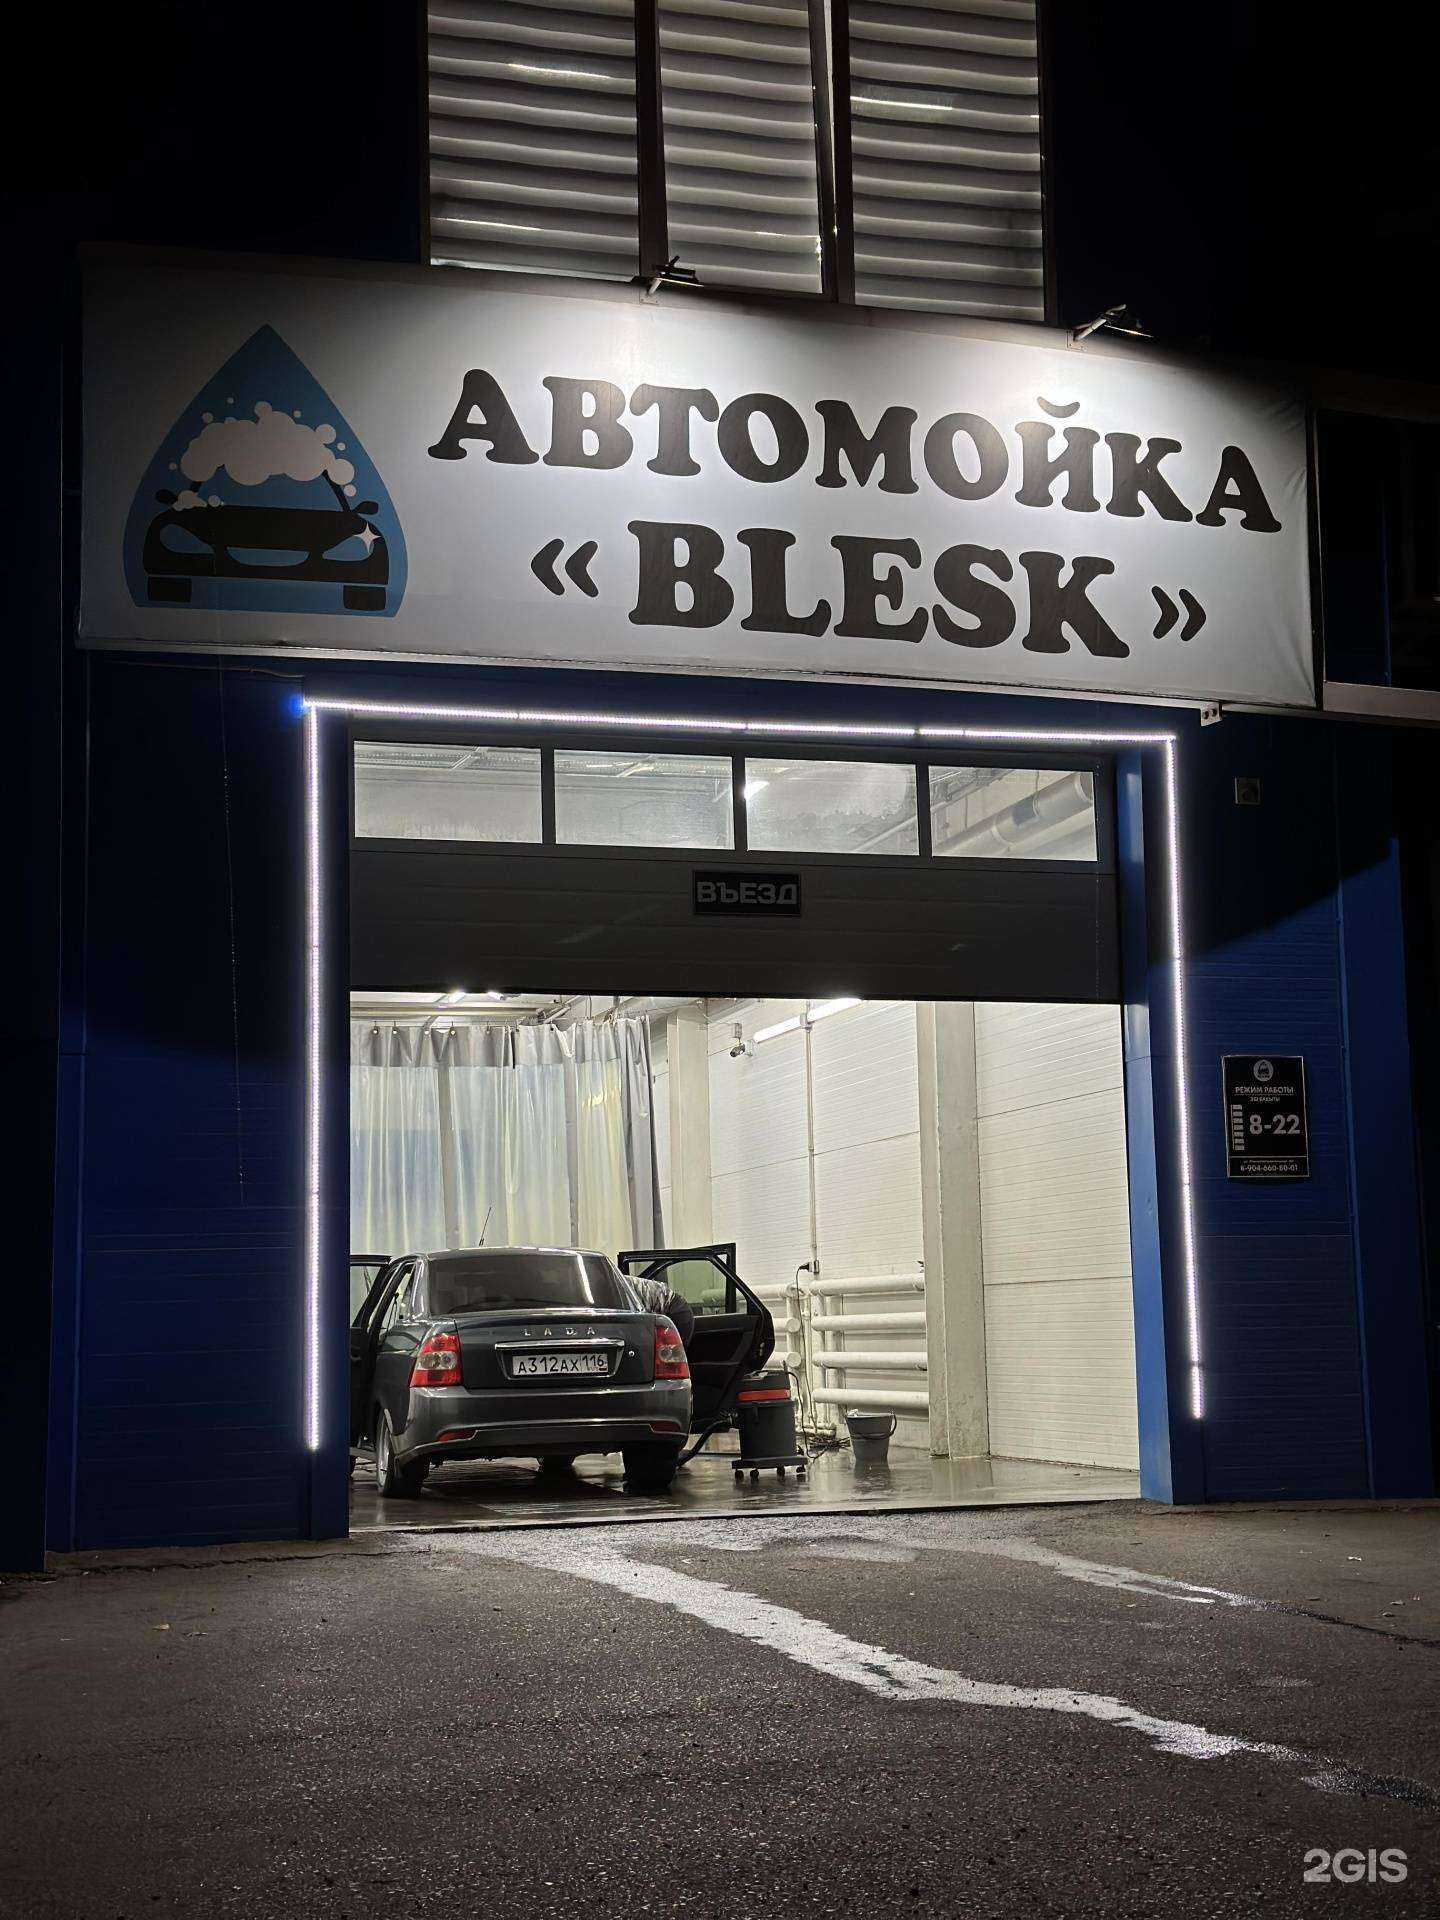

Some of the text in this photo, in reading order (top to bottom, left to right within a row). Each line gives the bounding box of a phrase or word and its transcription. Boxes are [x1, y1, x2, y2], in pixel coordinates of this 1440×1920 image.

[427, 368, 1281, 533] АВТОМОЙКА
[696, 881, 798, 905] ВЪЕЗД
[1235, 1086, 1294, 1094] РЕЖИМ РАБОТЫ
[1249, 1114, 1301, 1135] 8-22
[523, 1327, 596, 1336] LADA
